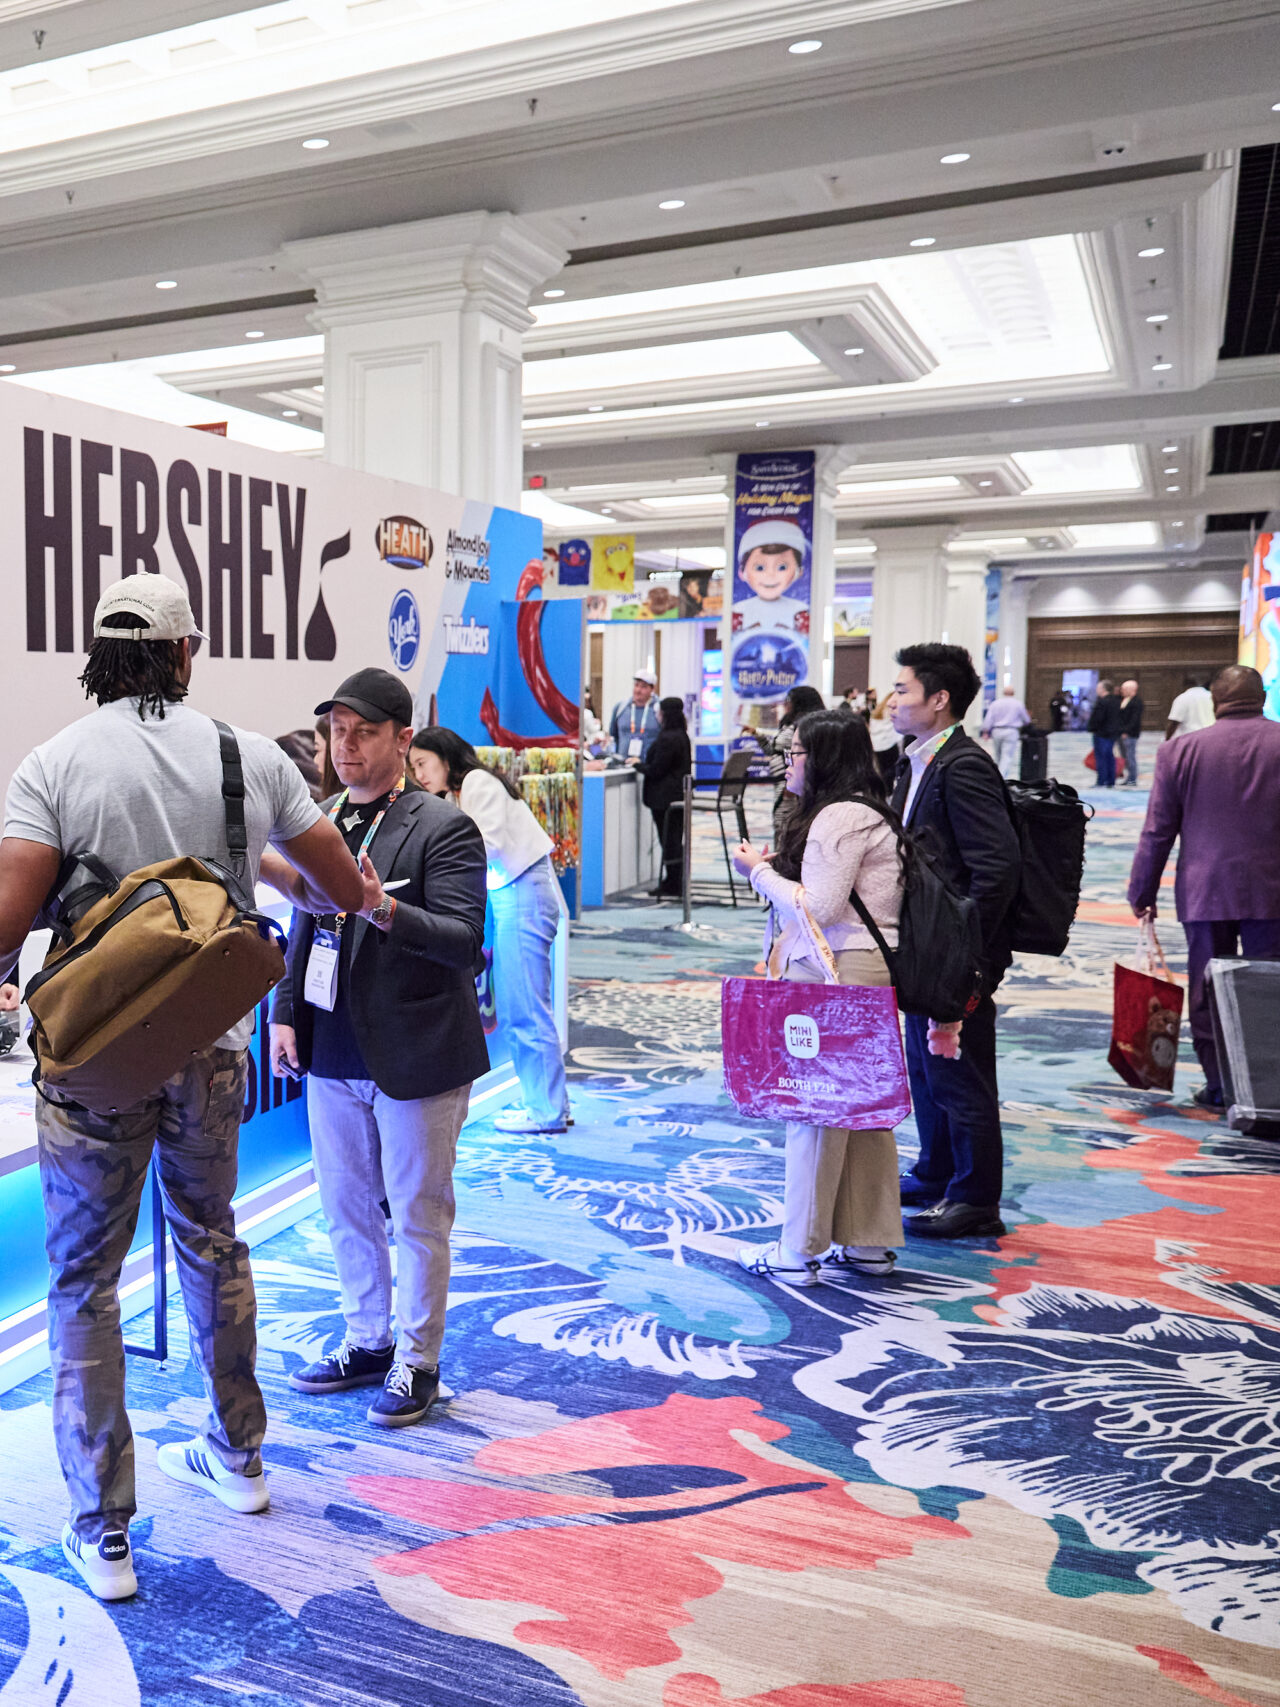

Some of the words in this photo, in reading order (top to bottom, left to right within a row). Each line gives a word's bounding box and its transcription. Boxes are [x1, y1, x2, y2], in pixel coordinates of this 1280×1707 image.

[22, 425, 307, 661] HERSHEY
[379, 518, 430, 568] HEATH
[790, 1037, 813, 1048] LIKE
[778, 1077, 811, 1091] BOOTH
[103, 1544, 126, 1554] adidas
